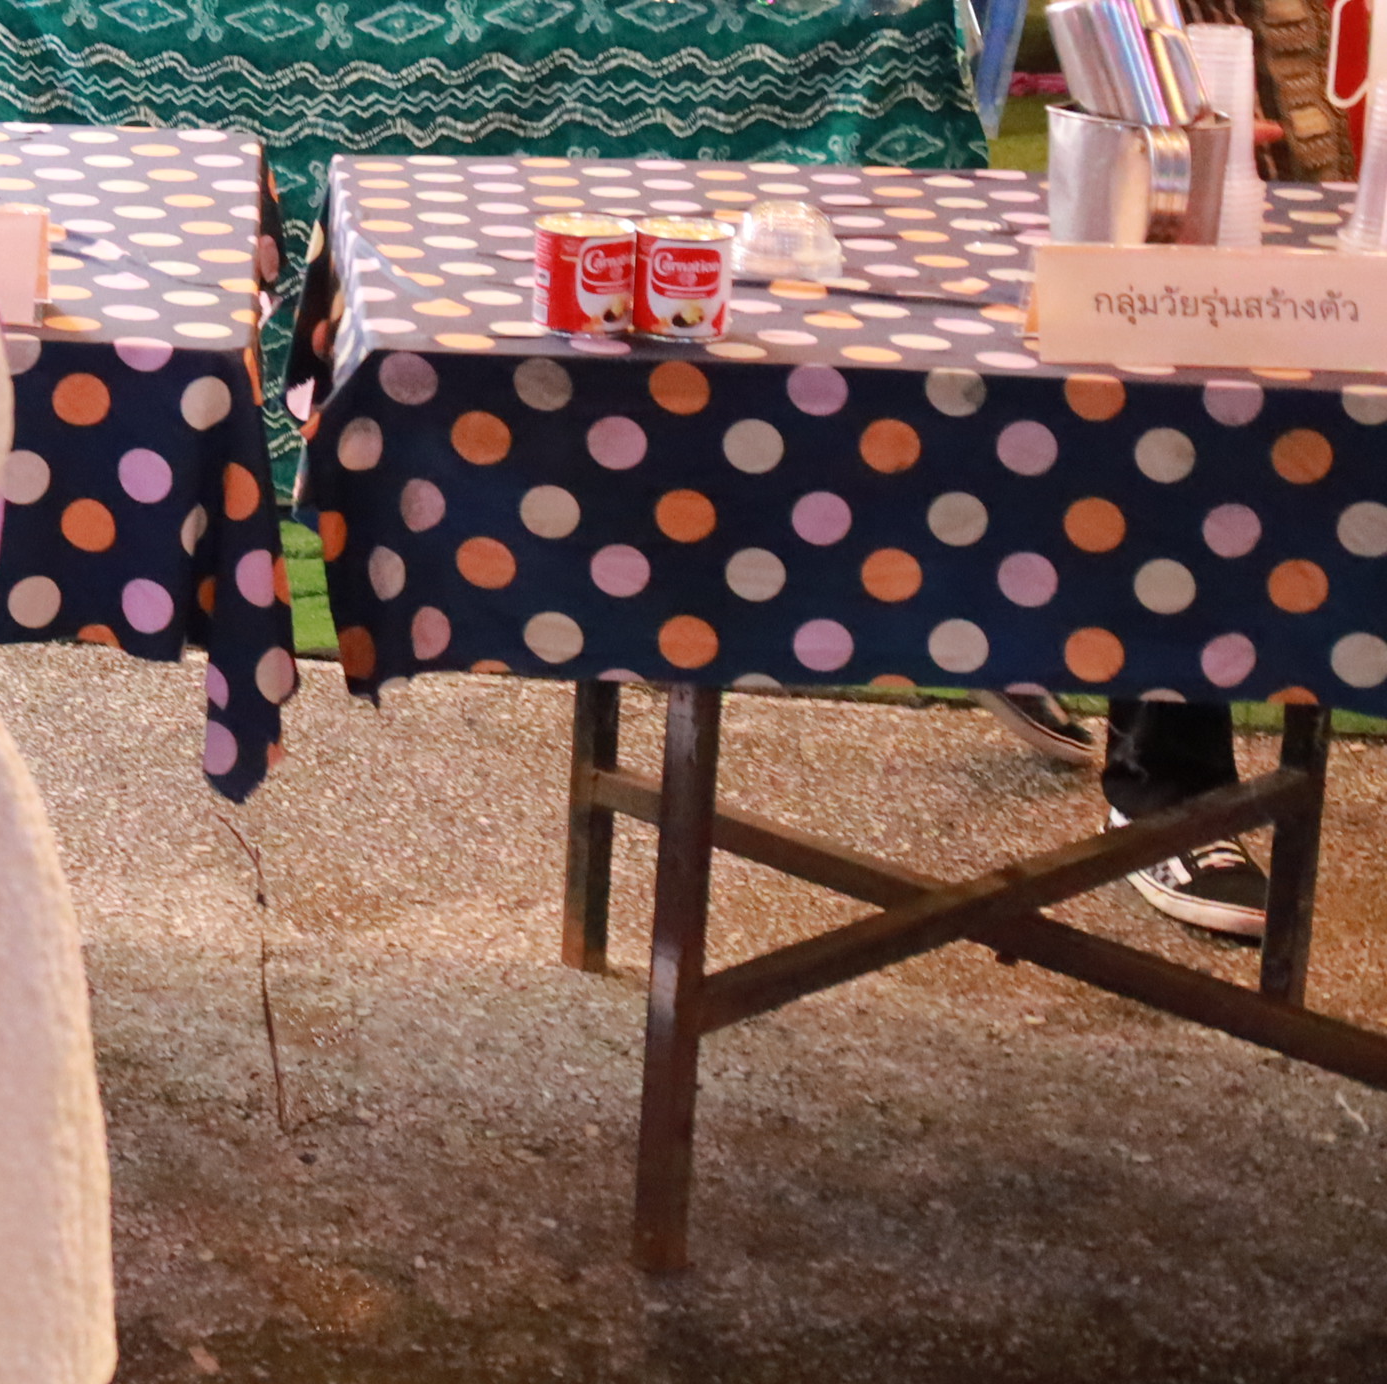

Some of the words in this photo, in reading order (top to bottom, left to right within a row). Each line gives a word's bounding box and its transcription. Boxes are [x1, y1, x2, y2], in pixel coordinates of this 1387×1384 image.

[1093, 285, 1361, 328] กลุ่มวัยรุ่นสร้างตัว
